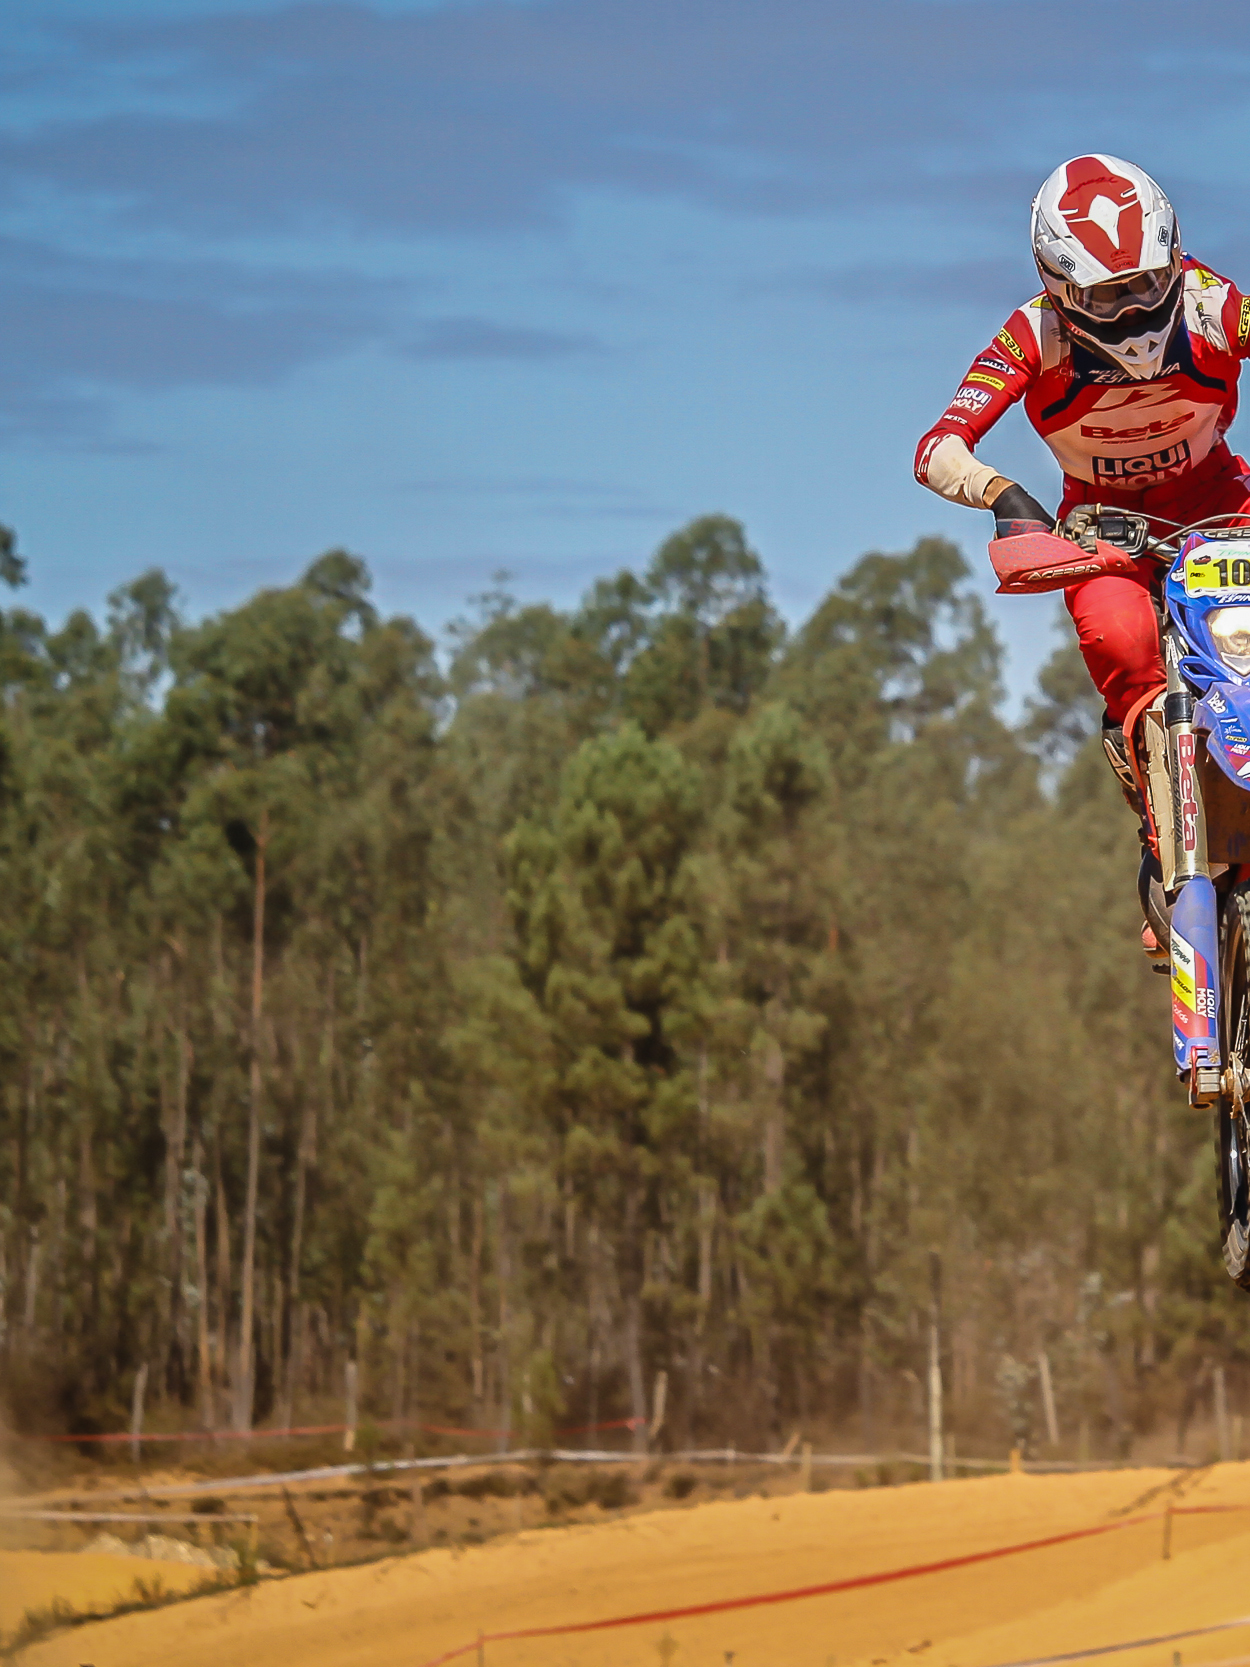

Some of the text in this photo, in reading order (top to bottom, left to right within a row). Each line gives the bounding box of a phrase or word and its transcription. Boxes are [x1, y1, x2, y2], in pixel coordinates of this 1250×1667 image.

[956, 388, 990, 404] LIQUI
[1080, 411, 1195, 438] Beta
[1097, 442, 1186, 475] LIQUI
[1177, 733, 1199, 852] Beta
[1196, 987, 1207, 1018] MOLY
[1206, 987, 1216, 1019] LIQUI
